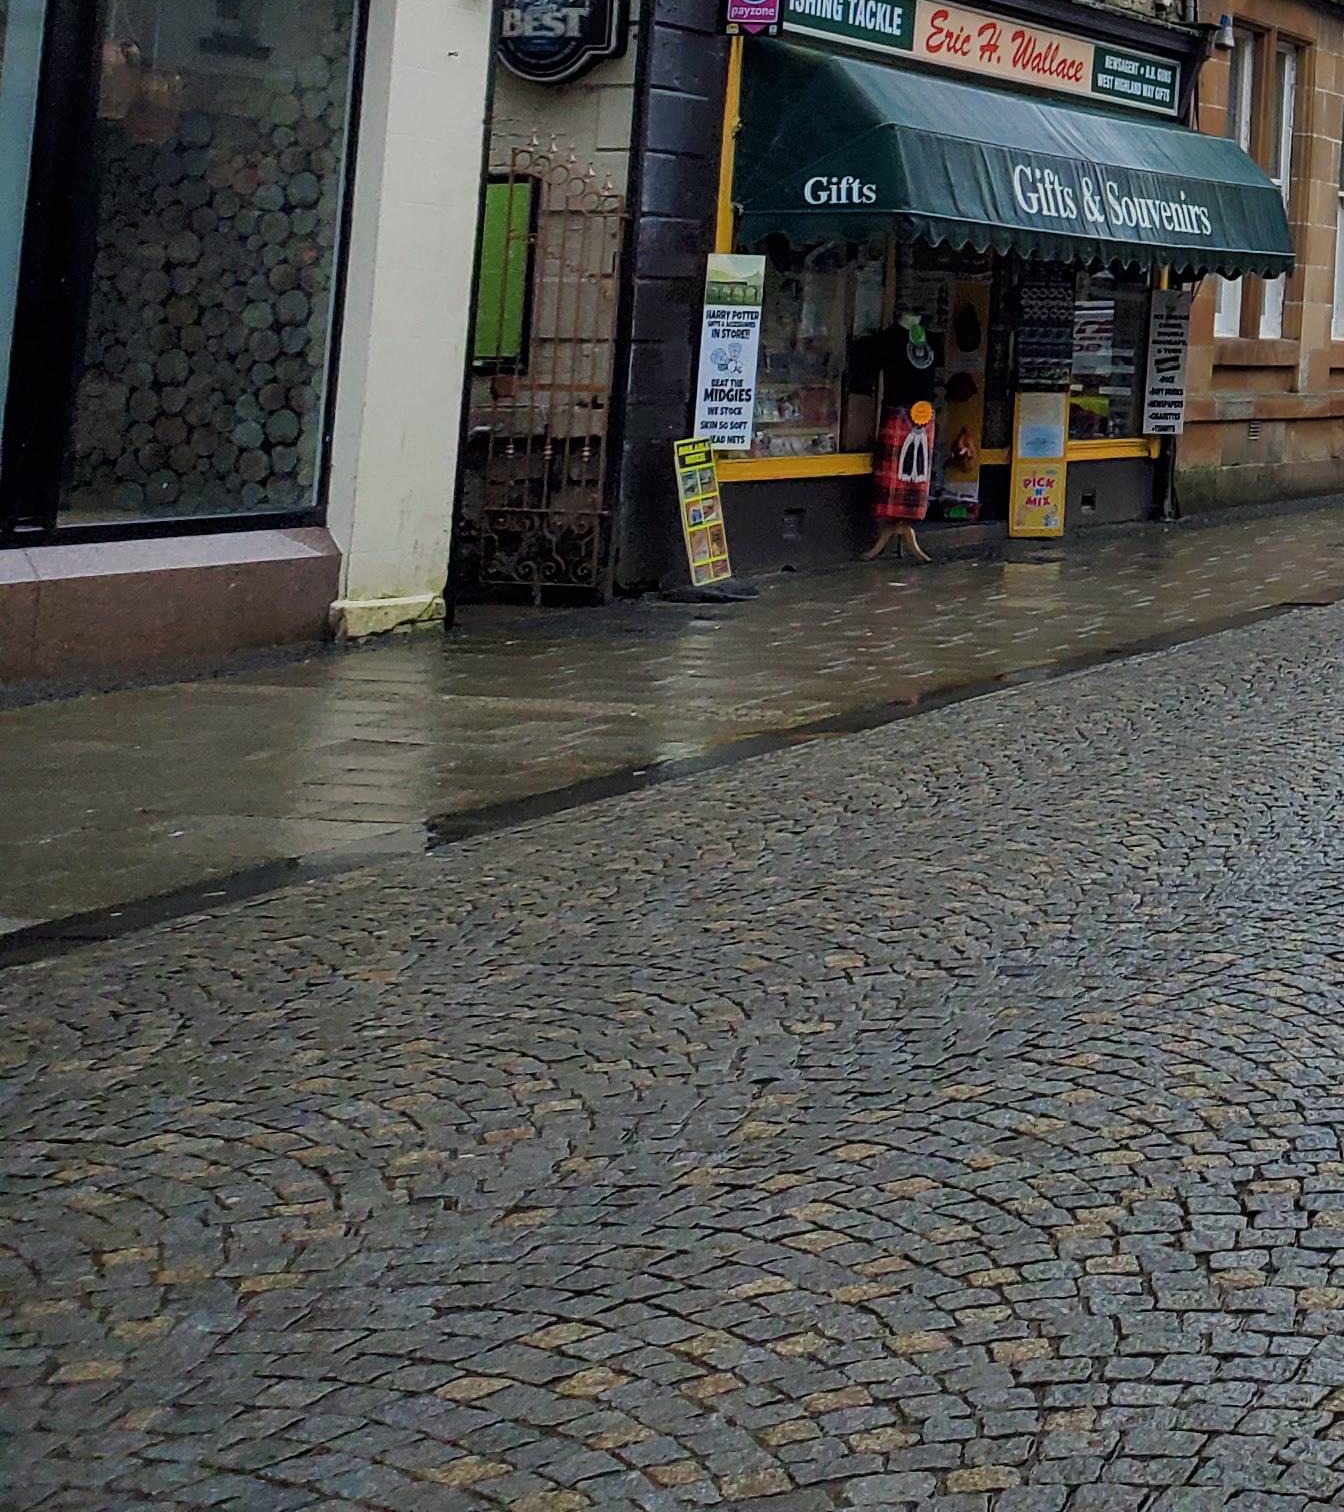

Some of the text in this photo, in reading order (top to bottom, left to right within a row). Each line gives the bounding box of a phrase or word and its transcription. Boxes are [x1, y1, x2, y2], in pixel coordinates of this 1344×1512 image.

[731, 6, 776, 19] payzone
[502, 7, 591, 38] BEST
[925, 9, 1083, 83] Eric H. Wallace
[1097, 72, 1114, 90] WEST
[1114, 77, 1142, 96] HIGHLAND
[1155, 86, 1171, 103] GIFTS
[803, 176, 877, 205] Gifts
[1012, 164, 1212, 236] Gifts & Souvenirs
[706, 310, 759, 320] HARRY POTTER
[711, 329, 720, 338] IN
[711, 378, 744, 387] BEAT THE
[703, 388, 752, 403] MIDGIES
[707, 407, 743, 416] WE STOCK
[700, 421, 748, 430] SKIN SO SOFT
[727, 434, 746, 444] NETS
[1023, 477, 1055, 489] PICK
[1025, 496, 1051, 506] MIX
